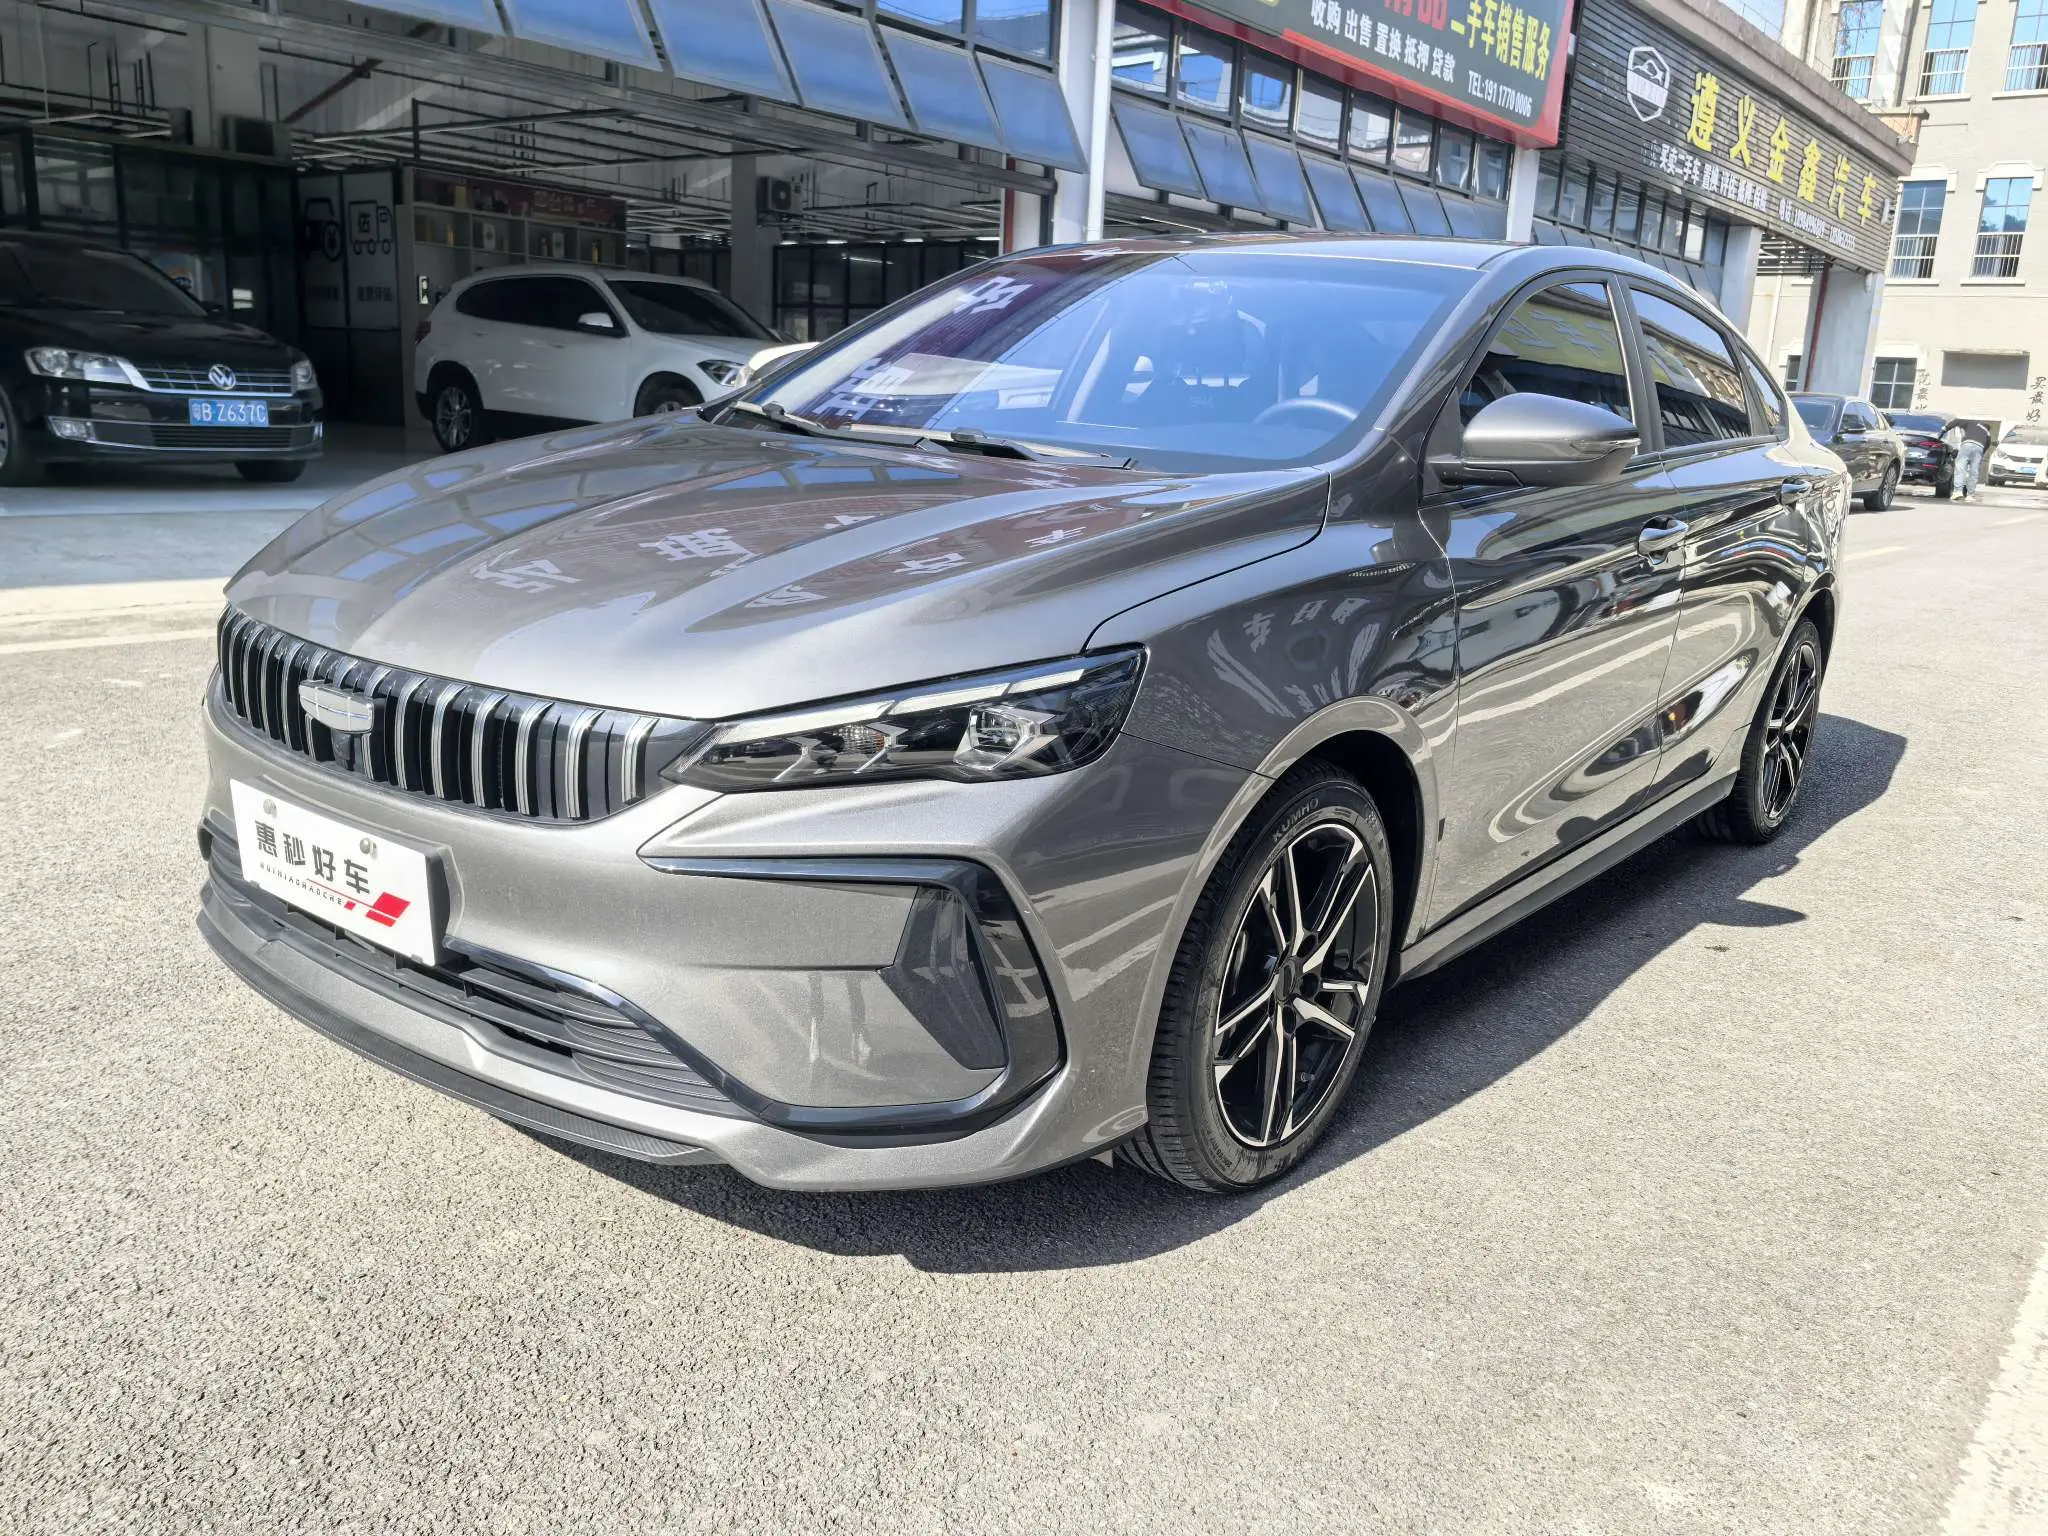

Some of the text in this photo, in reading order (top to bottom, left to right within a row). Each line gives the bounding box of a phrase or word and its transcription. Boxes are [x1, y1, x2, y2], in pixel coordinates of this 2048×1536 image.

[1311, 0, 1341, 35] 收购
[1345, 7, 1373, 48] 出售
[1374, 22, 1401, 62] 置换
[1404, 33, 1431, 73] 抵押
[1431, 47, 1456, 84] 贷款
[1659, 143, 1702, 185] 买卖二手车
[1686, 72, 1877, 227] 遵义金鑫汽车
[1272, 797, 1320, 842] KUMHO
[255, 820, 370, 895] 惠秒好车
